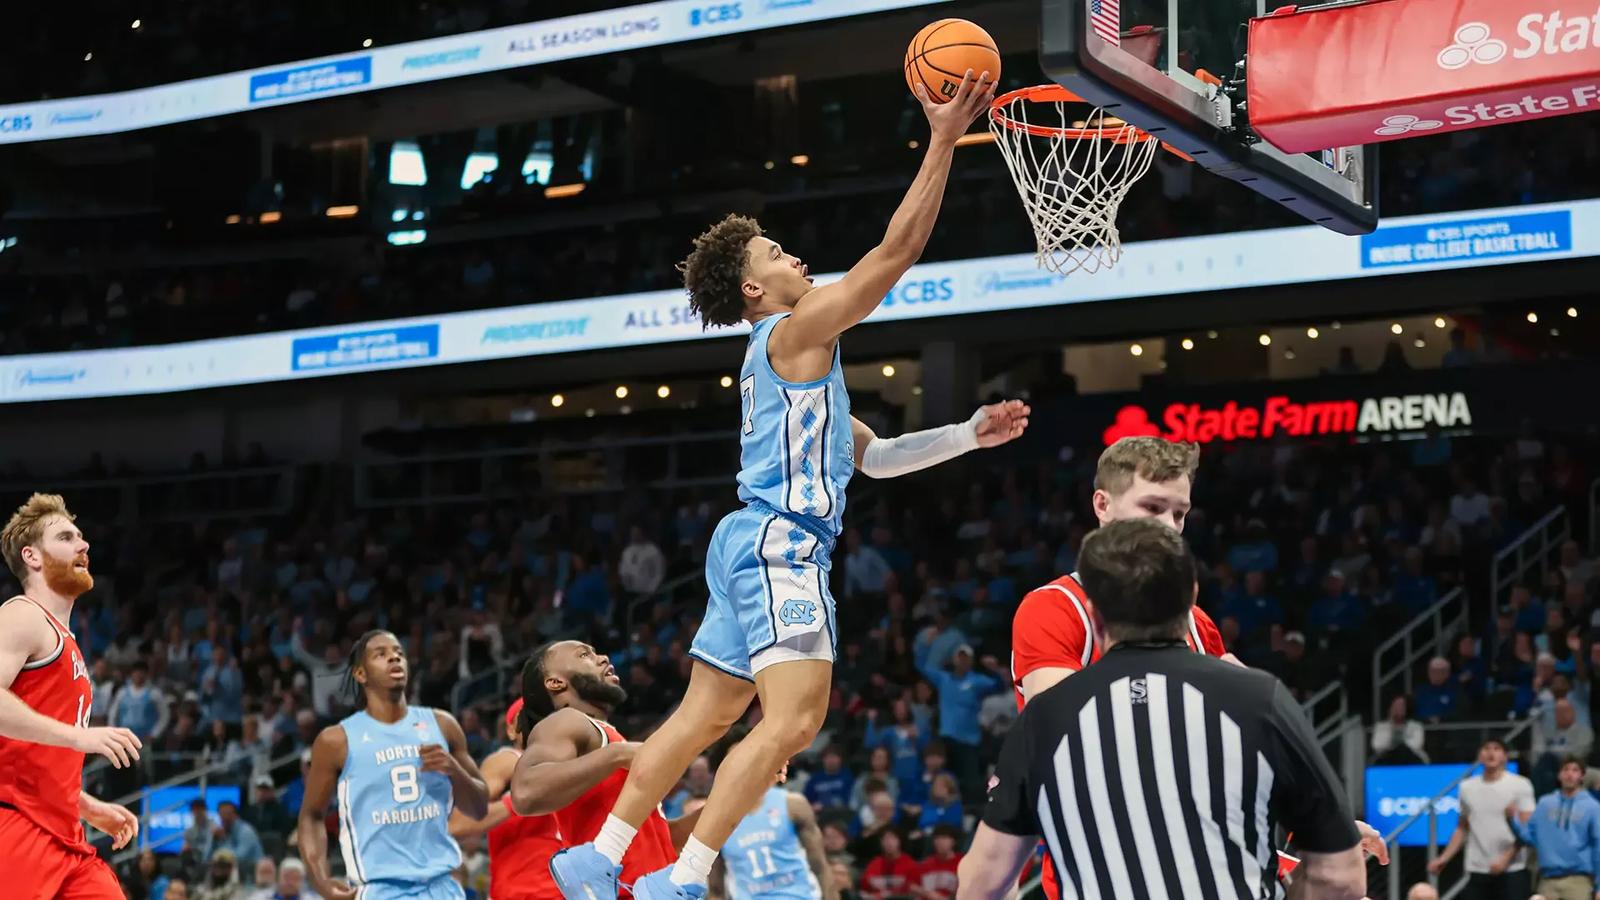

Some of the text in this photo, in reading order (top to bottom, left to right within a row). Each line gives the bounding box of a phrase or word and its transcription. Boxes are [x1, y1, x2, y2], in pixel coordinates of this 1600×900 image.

[704, 3, 743, 24] CBS
[508, 16, 660, 52] ALL SEASON LONG
[1443, 85, 1600, 125] State F
[900, 277, 954, 304] CBS
[624, 309, 662, 328] ALL
[1162, 392, 1472, 443] State Farm ARENA
[390, 764, 420, 804] 8
[372, 802, 440, 825] CAROLINA
[746, 846, 777, 878] 11
